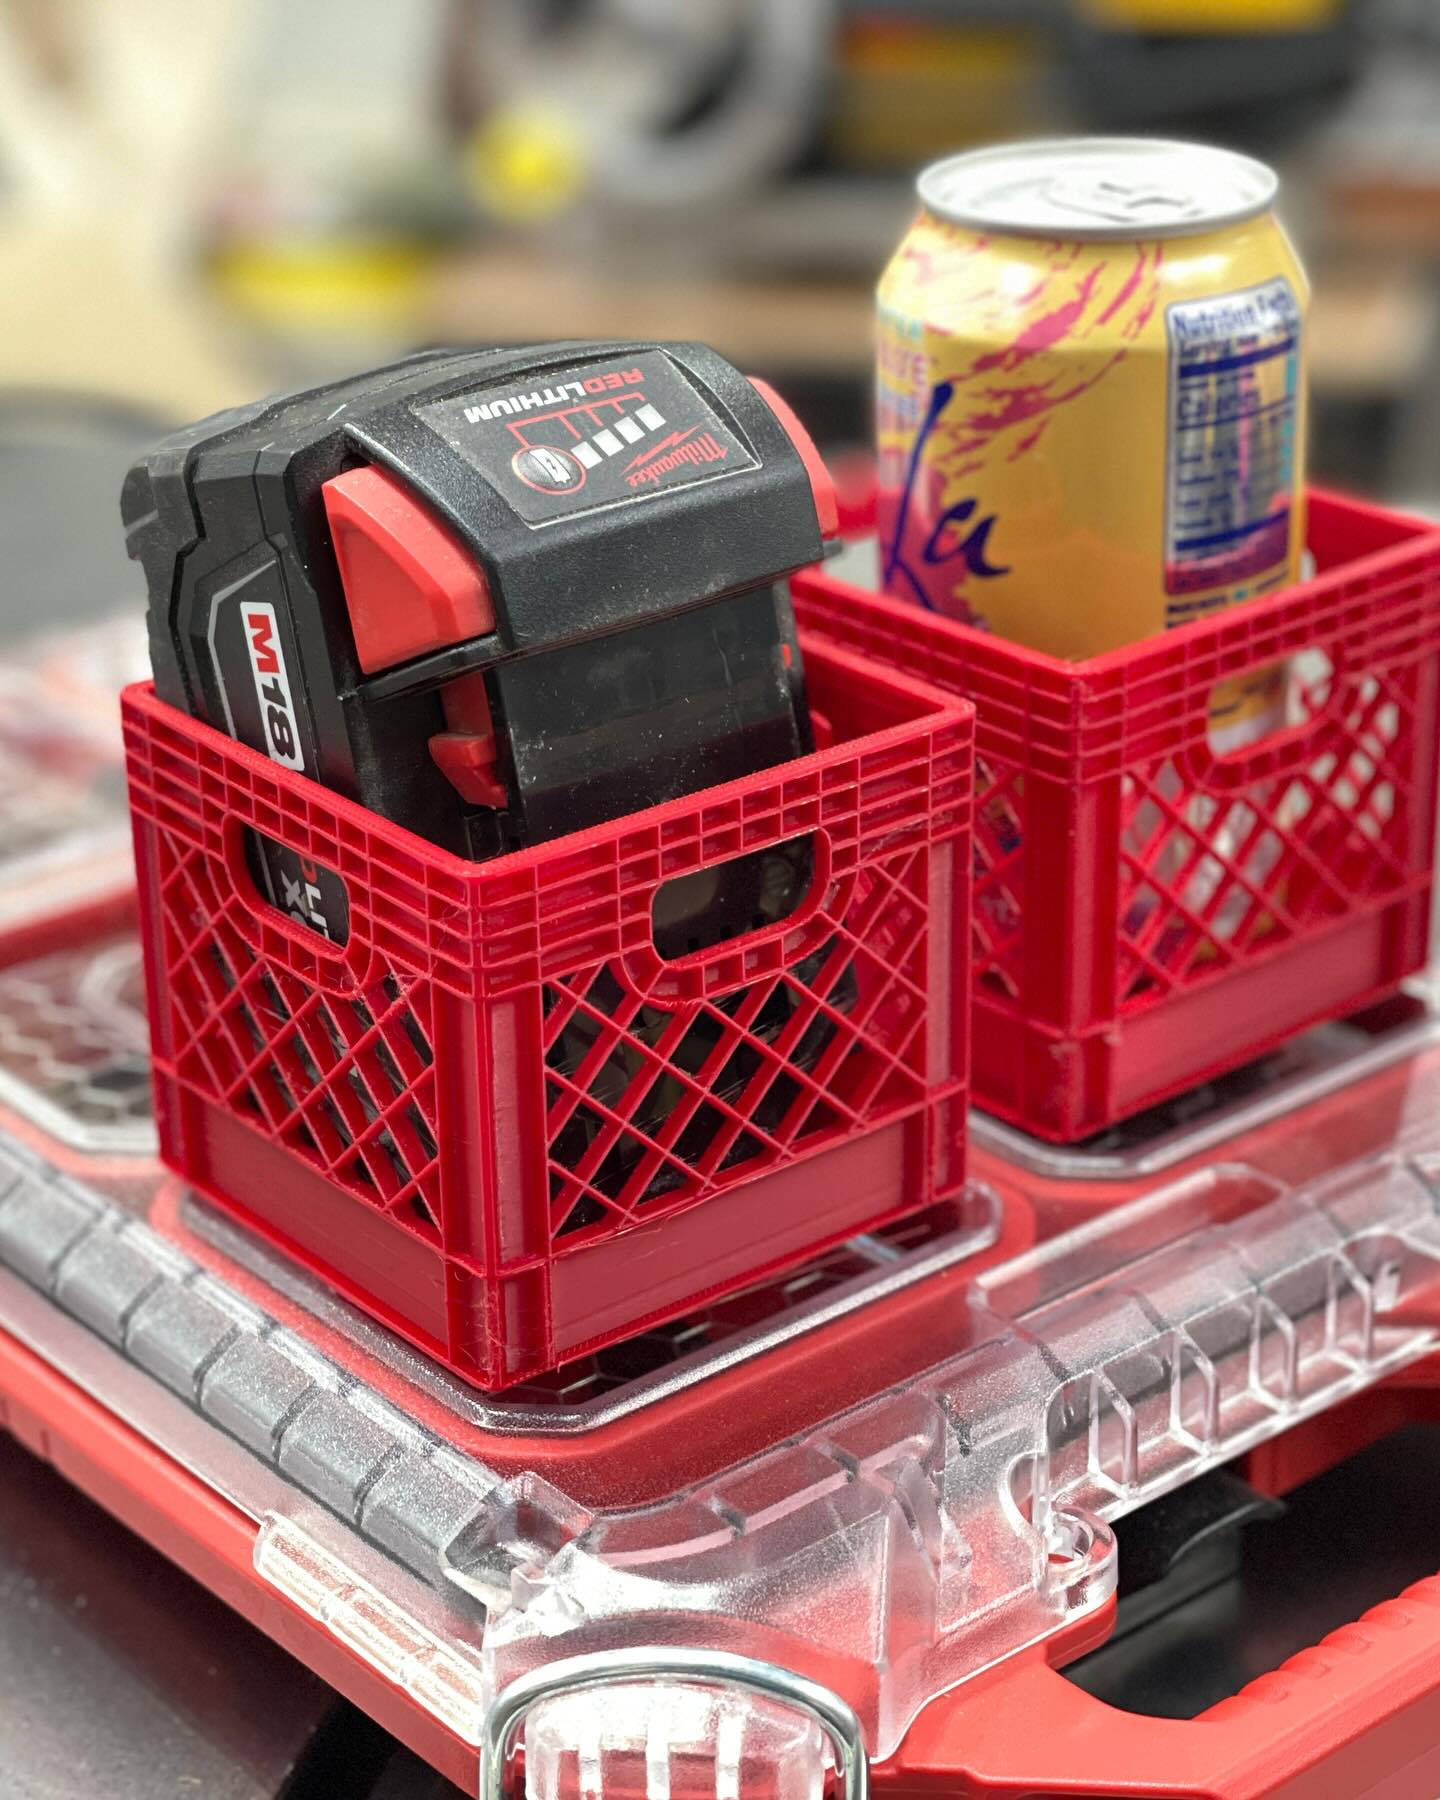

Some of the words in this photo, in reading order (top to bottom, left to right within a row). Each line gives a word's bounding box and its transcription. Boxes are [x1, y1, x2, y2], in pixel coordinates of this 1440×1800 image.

[464, 368, 645, 424] REDLITHIUM
[625, 432, 728, 488] Milwaukee
[247, 613, 297, 761] M18
